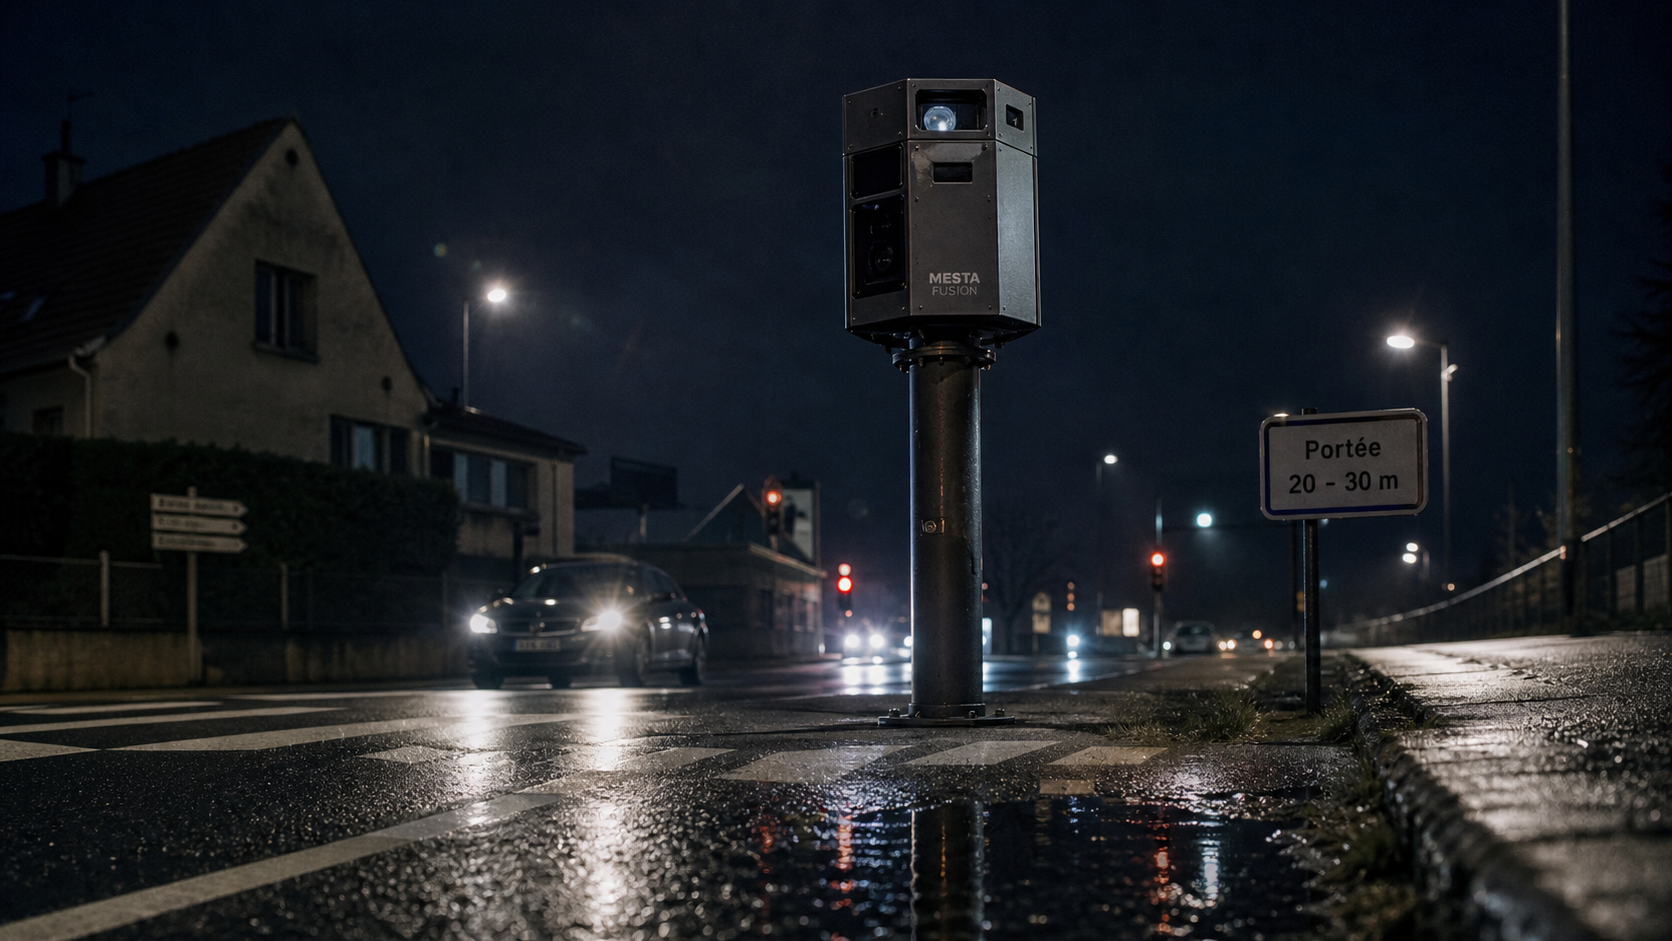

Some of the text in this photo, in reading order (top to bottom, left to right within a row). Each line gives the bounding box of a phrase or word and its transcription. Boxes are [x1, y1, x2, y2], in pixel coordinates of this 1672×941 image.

[929, 272, 980, 284] MESTA
[932, 285, 977, 296] FUSION
[1306, 437, 1381, 459] Portée
[1289, 474, 1315, 494] 20
[1345, 471, 1371, 491] 30
[1379, 474, 1398, 490] m
